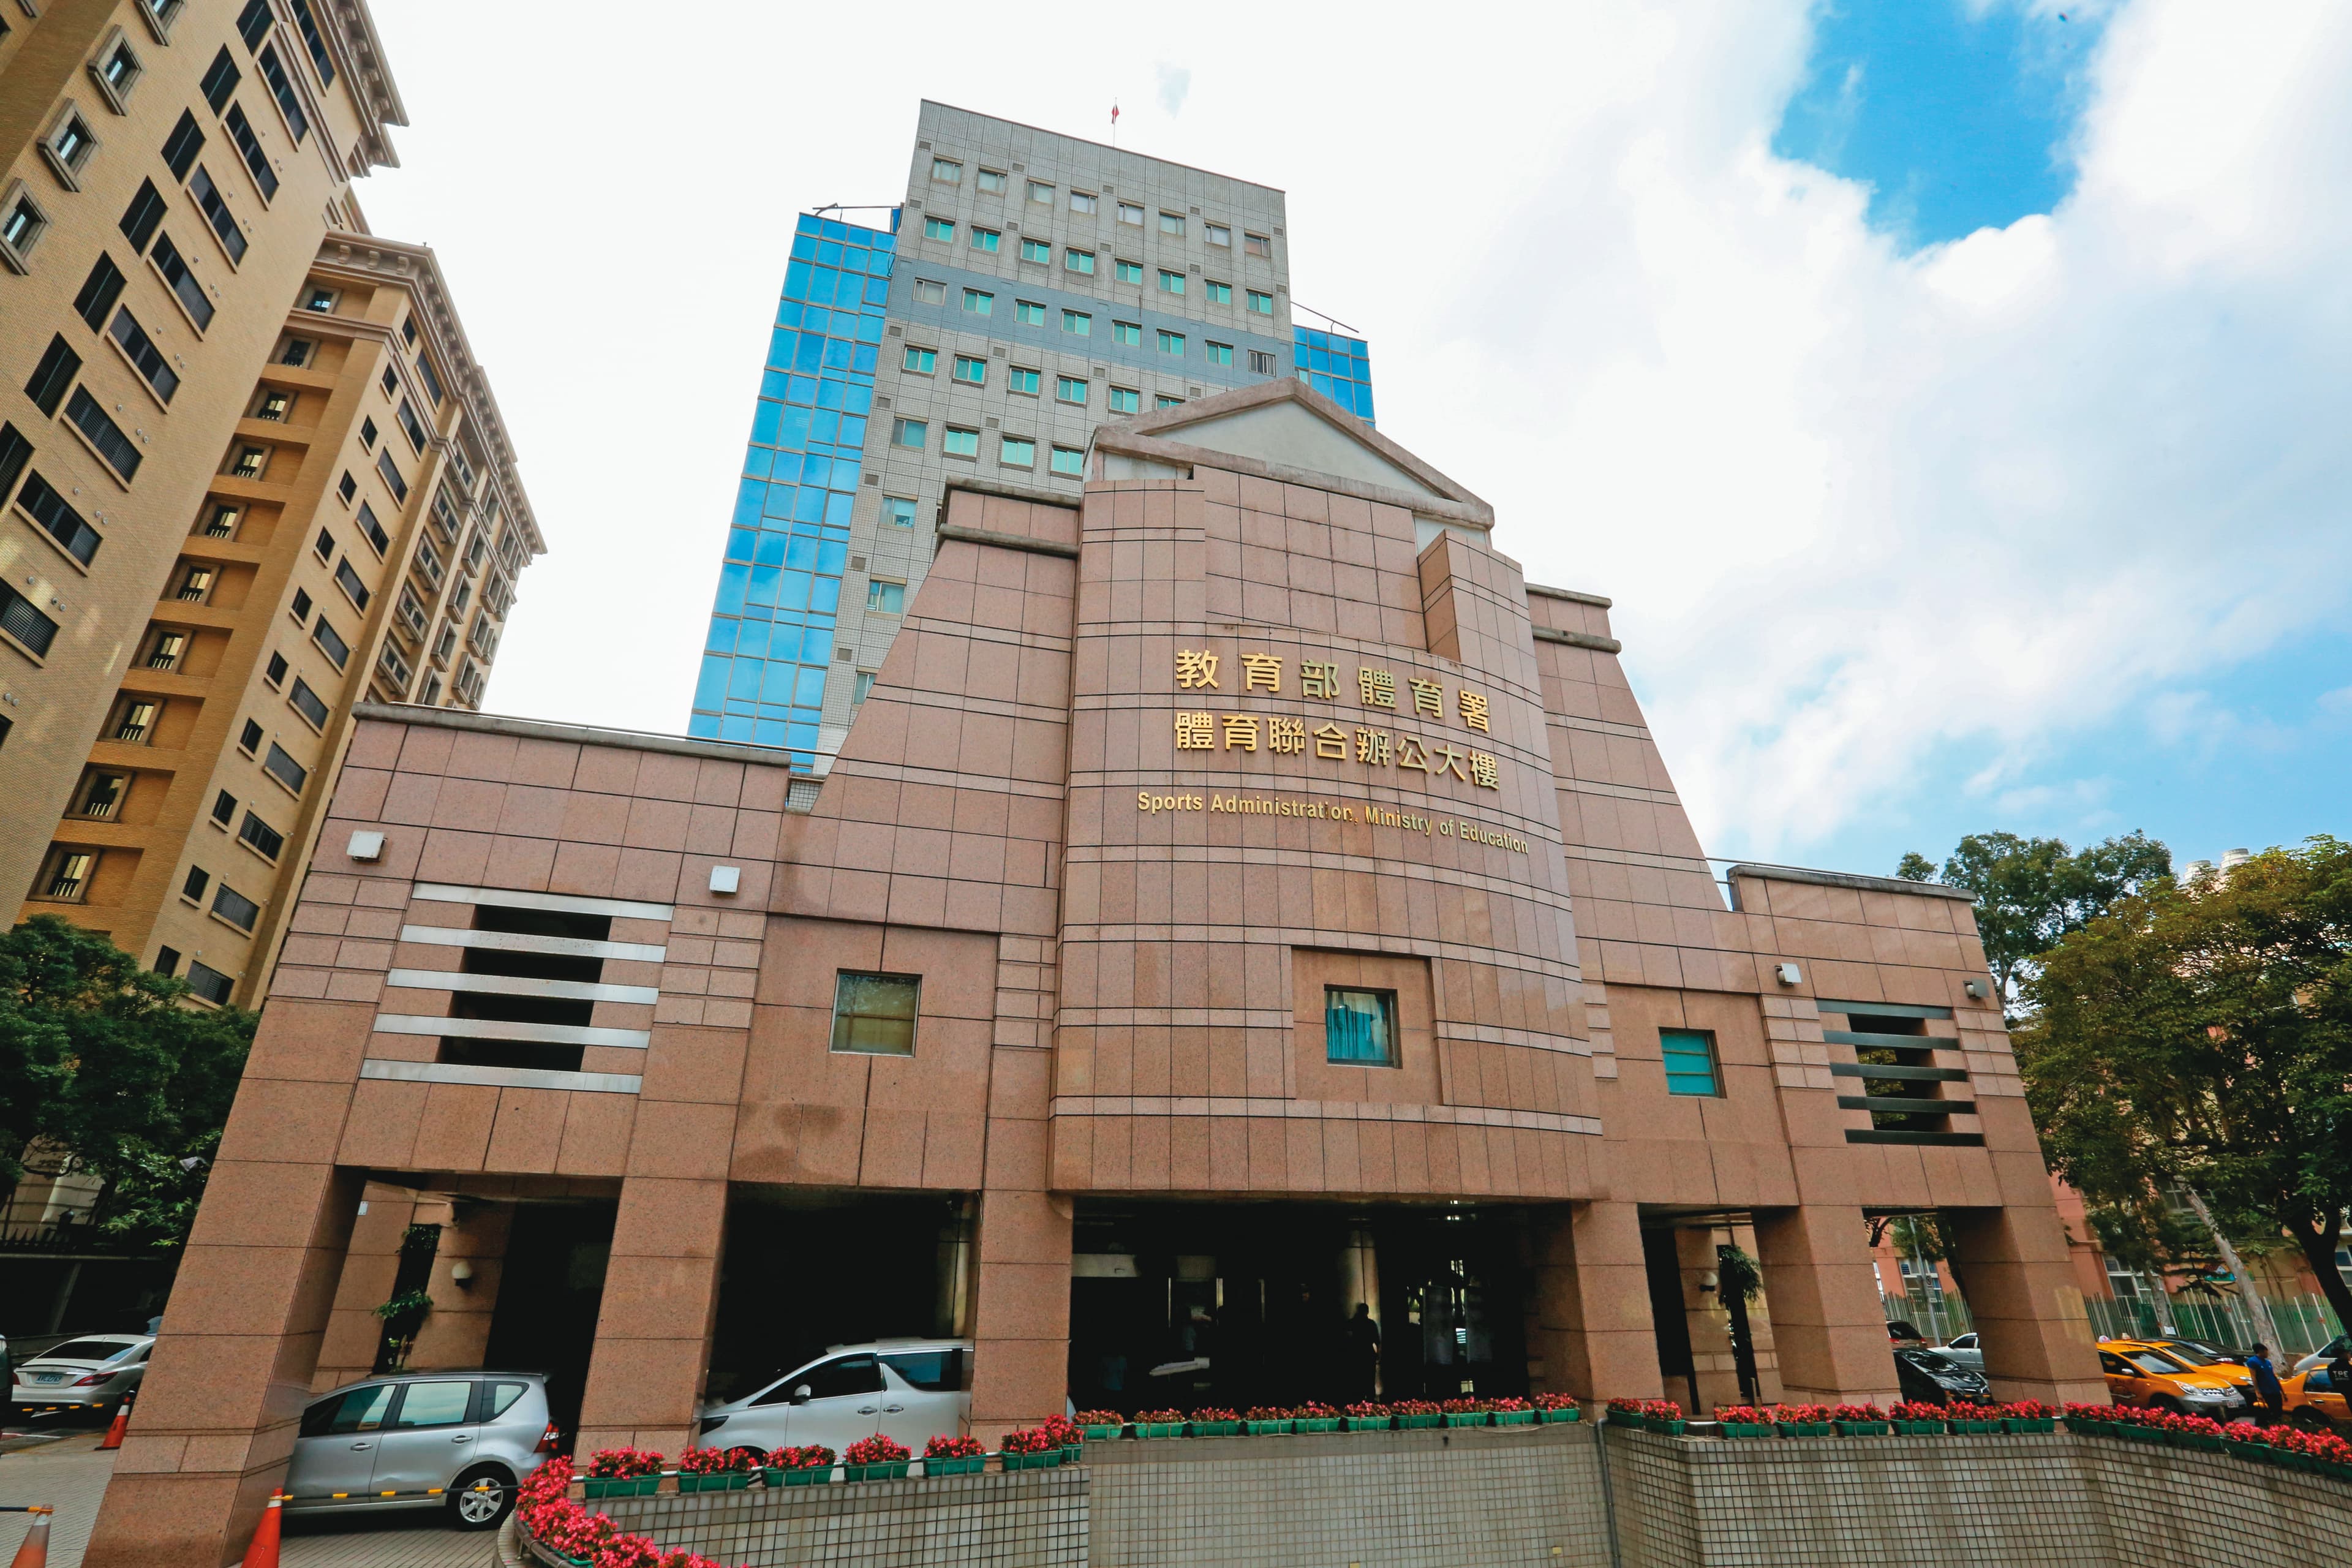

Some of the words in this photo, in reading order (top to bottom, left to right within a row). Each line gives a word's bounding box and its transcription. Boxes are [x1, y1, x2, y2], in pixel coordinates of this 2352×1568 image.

[1176, 649, 1490, 733] 教育部體育署
[1175, 712, 1500, 790] 體育聯合辦公大樓
[1137, 792, 1203, 815] Sports
[1365, 805, 1432, 837] Ministry
[1439, 819, 1453, 836] of
[1459, 821, 1529, 854] Education
